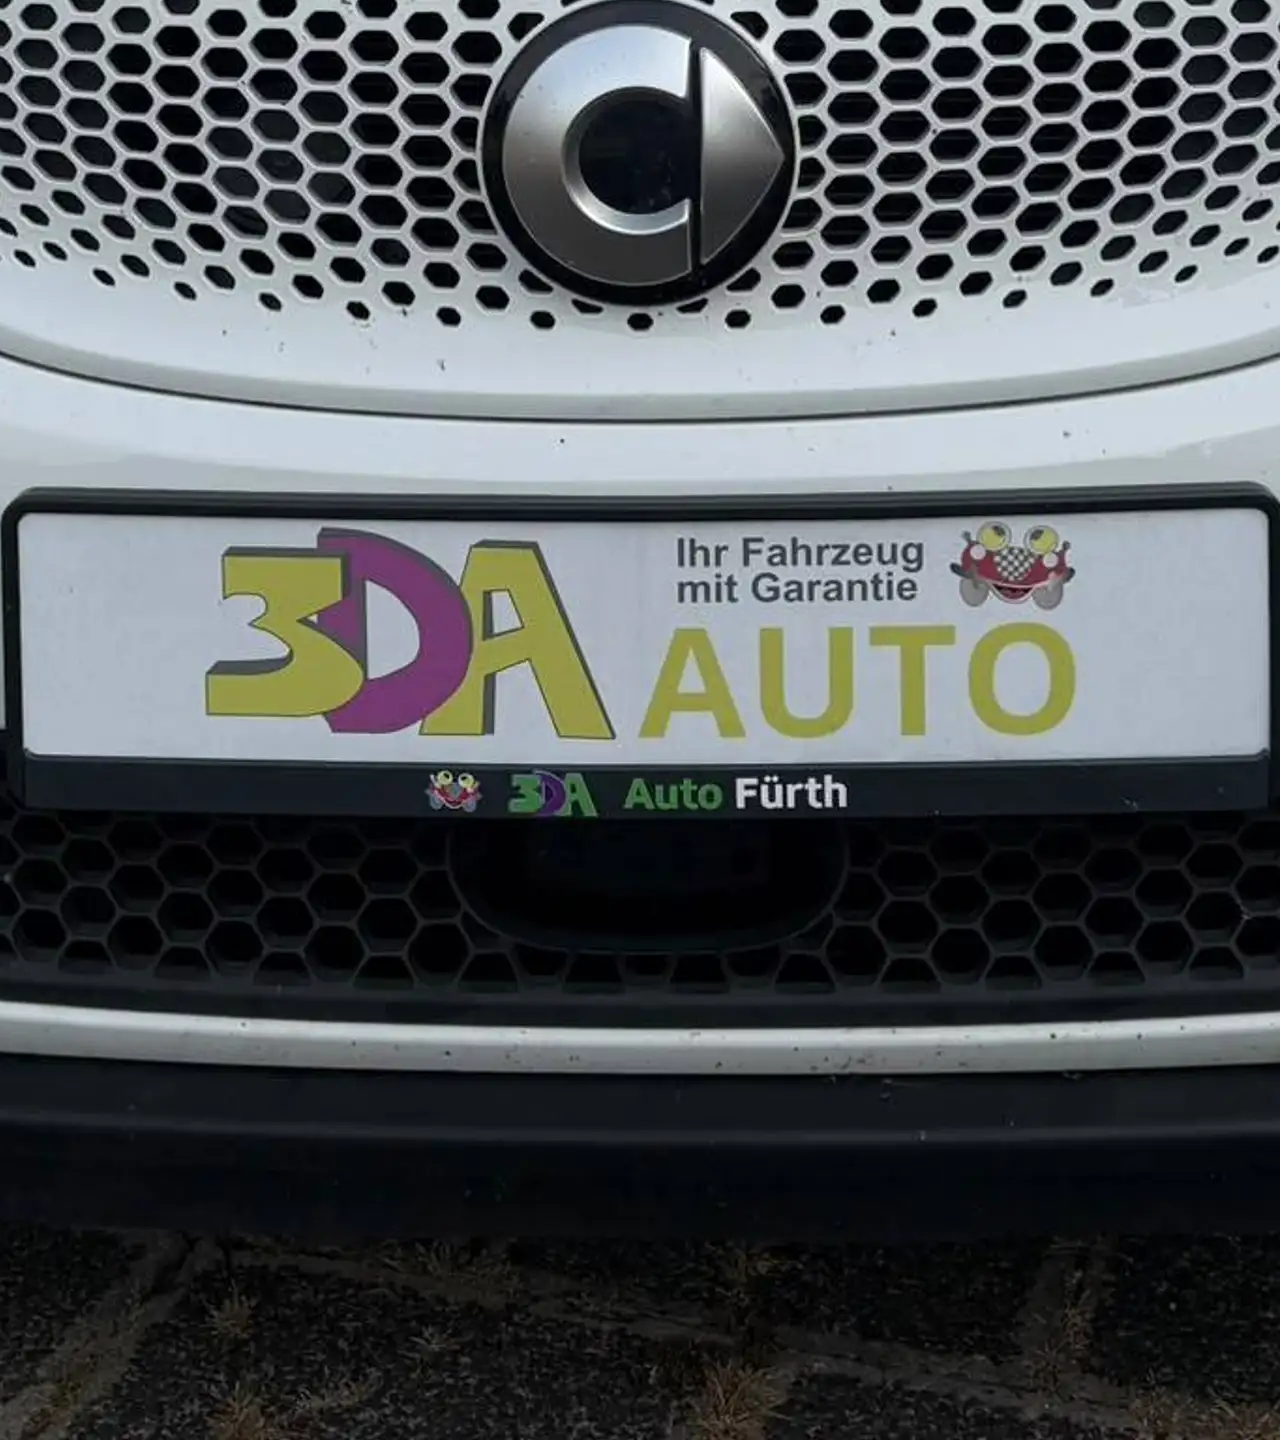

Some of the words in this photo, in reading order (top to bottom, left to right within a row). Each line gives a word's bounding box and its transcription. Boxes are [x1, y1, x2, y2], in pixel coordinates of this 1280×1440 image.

[676, 537, 729, 568] Ihr
[741, 537, 924, 572] Fahrzeug
[677, 573, 739, 604] mit
[751, 572, 918, 602] Garantie
[206, 527, 616, 739] 3DA
[638, 622, 1077, 739] AUTO
[507, 769, 598, 817] 3DA
[624, 777, 723, 811] Auto
[734, 775, 848, 810] Fürth
